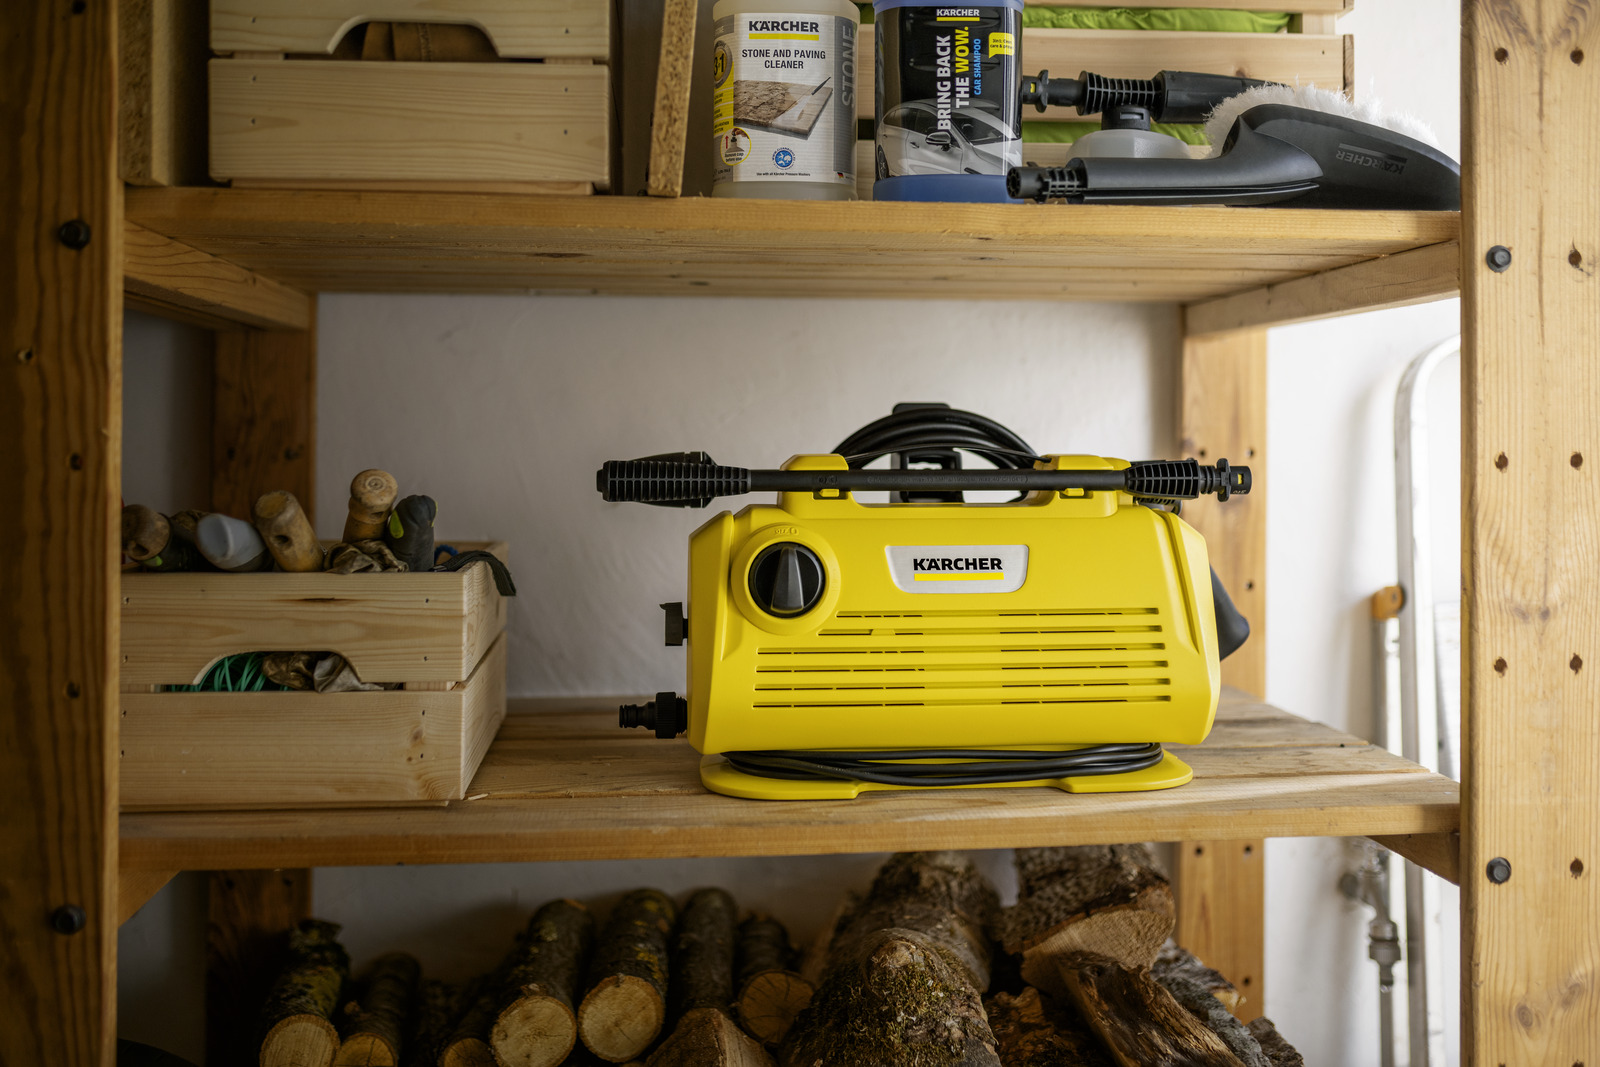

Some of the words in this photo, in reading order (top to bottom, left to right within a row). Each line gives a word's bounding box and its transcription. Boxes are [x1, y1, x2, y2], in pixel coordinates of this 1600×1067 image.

[936, 9, 980, 17] KÄRCHER
[748, 20, 820, 33] KÄRCHER
[741, 49, 772, 58] STONE
[773, 49, 792, 58] AND
[794, 50, 826, 59] PAVING
[936, 35, 951, 78] BACK
[955, 26, 970, 73] WOW.
[973, 38, 982, 78] SHAMPOO
[764, 60, 804, 69] CLEANER
[955, 77, 970, 108] THE
[973, 78, 982, 95] CAR
[936, 81, 952, 131] BRING
[1335, 149, 1405, 175] KÄRCHER
[913, 557, 1003, 571] KÄRCHER
